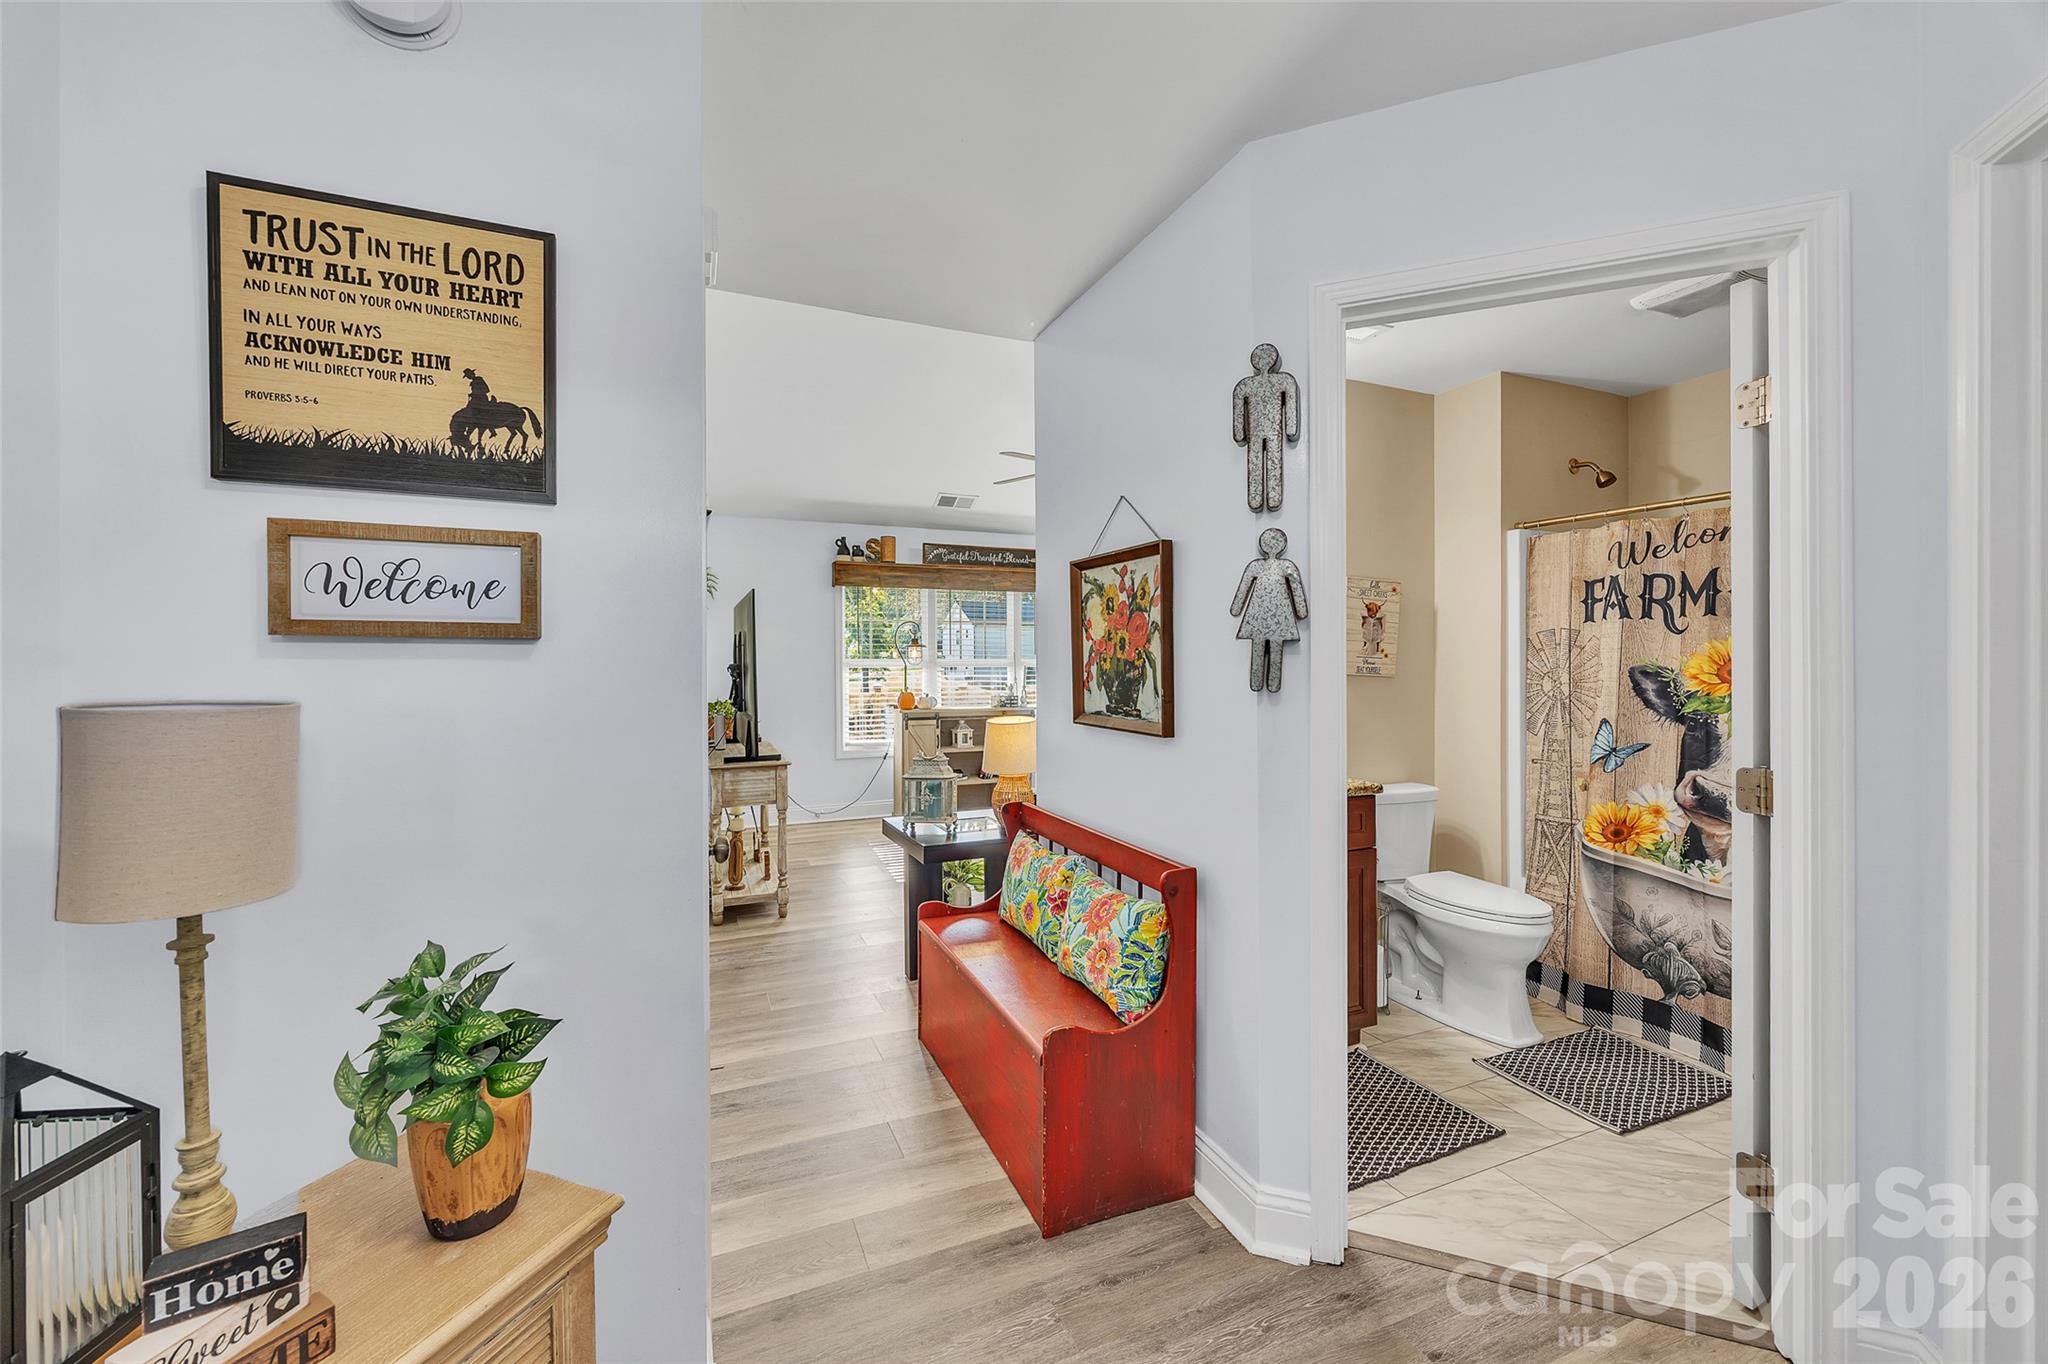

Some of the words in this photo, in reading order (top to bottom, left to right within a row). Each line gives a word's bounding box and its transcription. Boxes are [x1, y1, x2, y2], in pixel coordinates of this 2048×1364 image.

[242, 208, 364, 260] TRUST
[367, 235, 391, 260] IN
[397, 241, 437, 267] THE
[442, 242, 525, 286] LORD
[242, 249, 314, 279] WITH
[323, 262, 372, 287] ALL
[377, 270, 440, 298] YOUR
[449, 281, 523, 309] HEART
[243, 277, 271, 292] AND
[274, 281, 307, 297] LEAN
[310, 287, 336, 301] NOT
[338, 291, 356, 304] ON
[360, 293, 391, 309] YOUR
[394, 299, 422, 314] OWN
[425, 303, 522, 329] UNDERSTANDING,
[243, 308, 260, 324] IN
[265, 312, 292, 328] ALL
[296, 315, 336, 334] YOUR
[341, 321, 382, 339] WAYS
[244, 331, 403, 366] ACKNOWLEDGE
[411, 351, 451, 371] HIM
[244, 354, 271, 368] AND
[274, 357, 290, 370] HE
[293, 359, 322, 373] WILL
[324, 363, 364, 378] DIRECT
[366, 368, 397, 382] YOUR
[400, 372, 438, 387] PATHS.
[244, 389, 293, 403] PROVERBS
[1607, 519, 1732, 570] Welco
[304, 555, 507, 610] Welcome
[1580, 567, 1732, 635] FARM
[149, 1255, 295, 1324] Home
